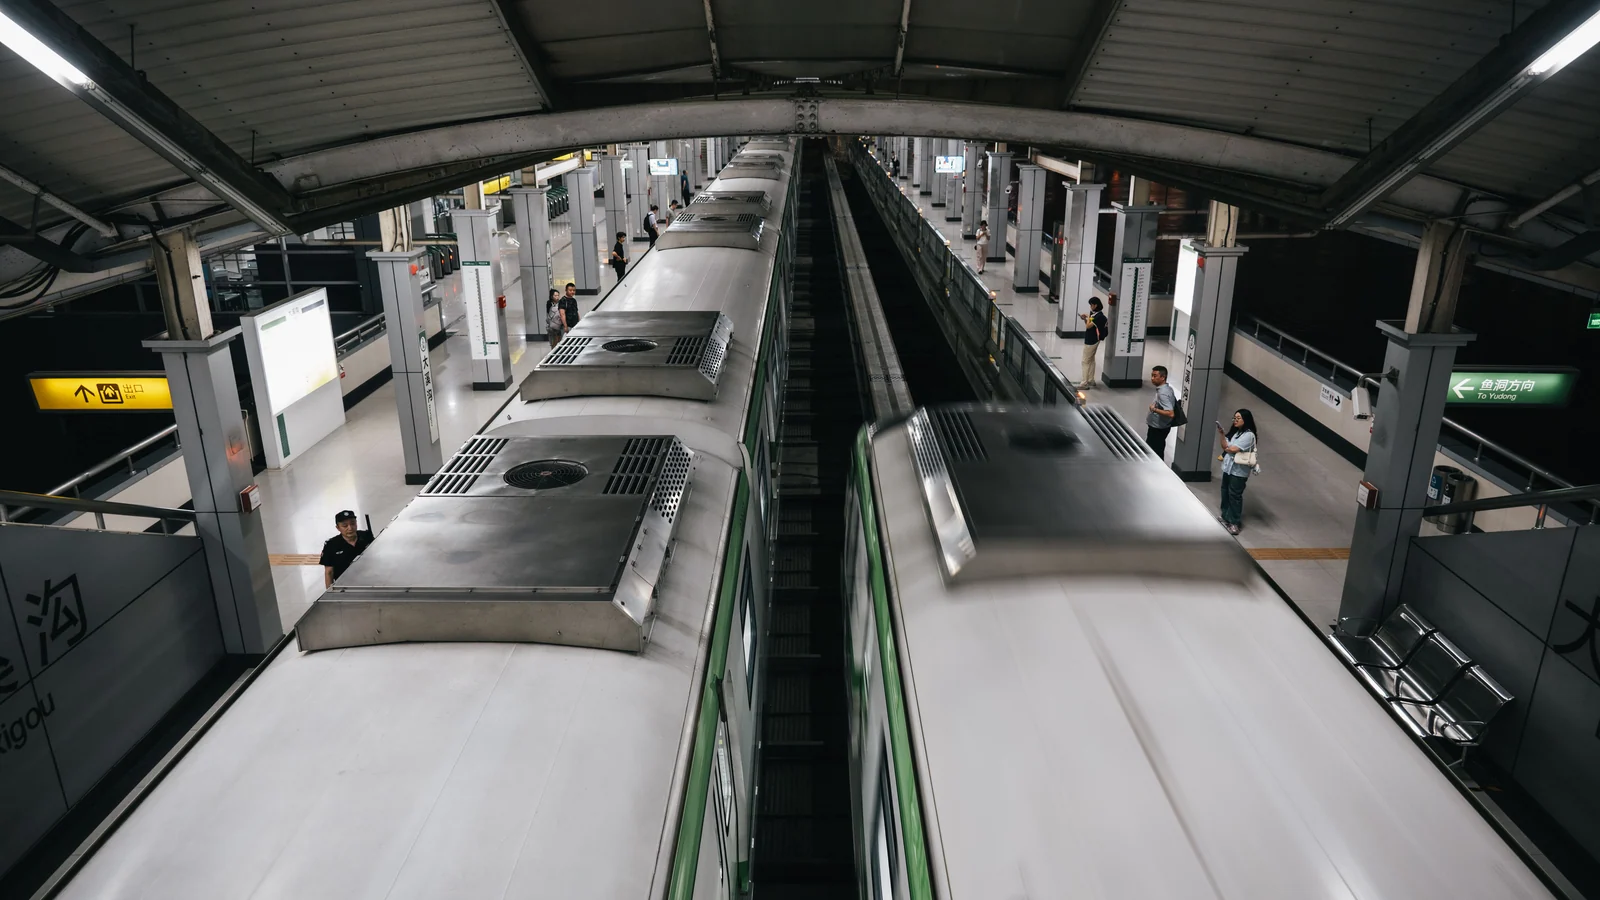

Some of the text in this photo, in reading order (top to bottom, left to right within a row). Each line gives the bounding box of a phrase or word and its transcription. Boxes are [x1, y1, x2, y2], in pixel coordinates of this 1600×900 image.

[123, 384, 144, 393] 出口
[1479, 378, 1536, 392] 鱼洞方向
[1489, 392, 1517, 401] Yudong
